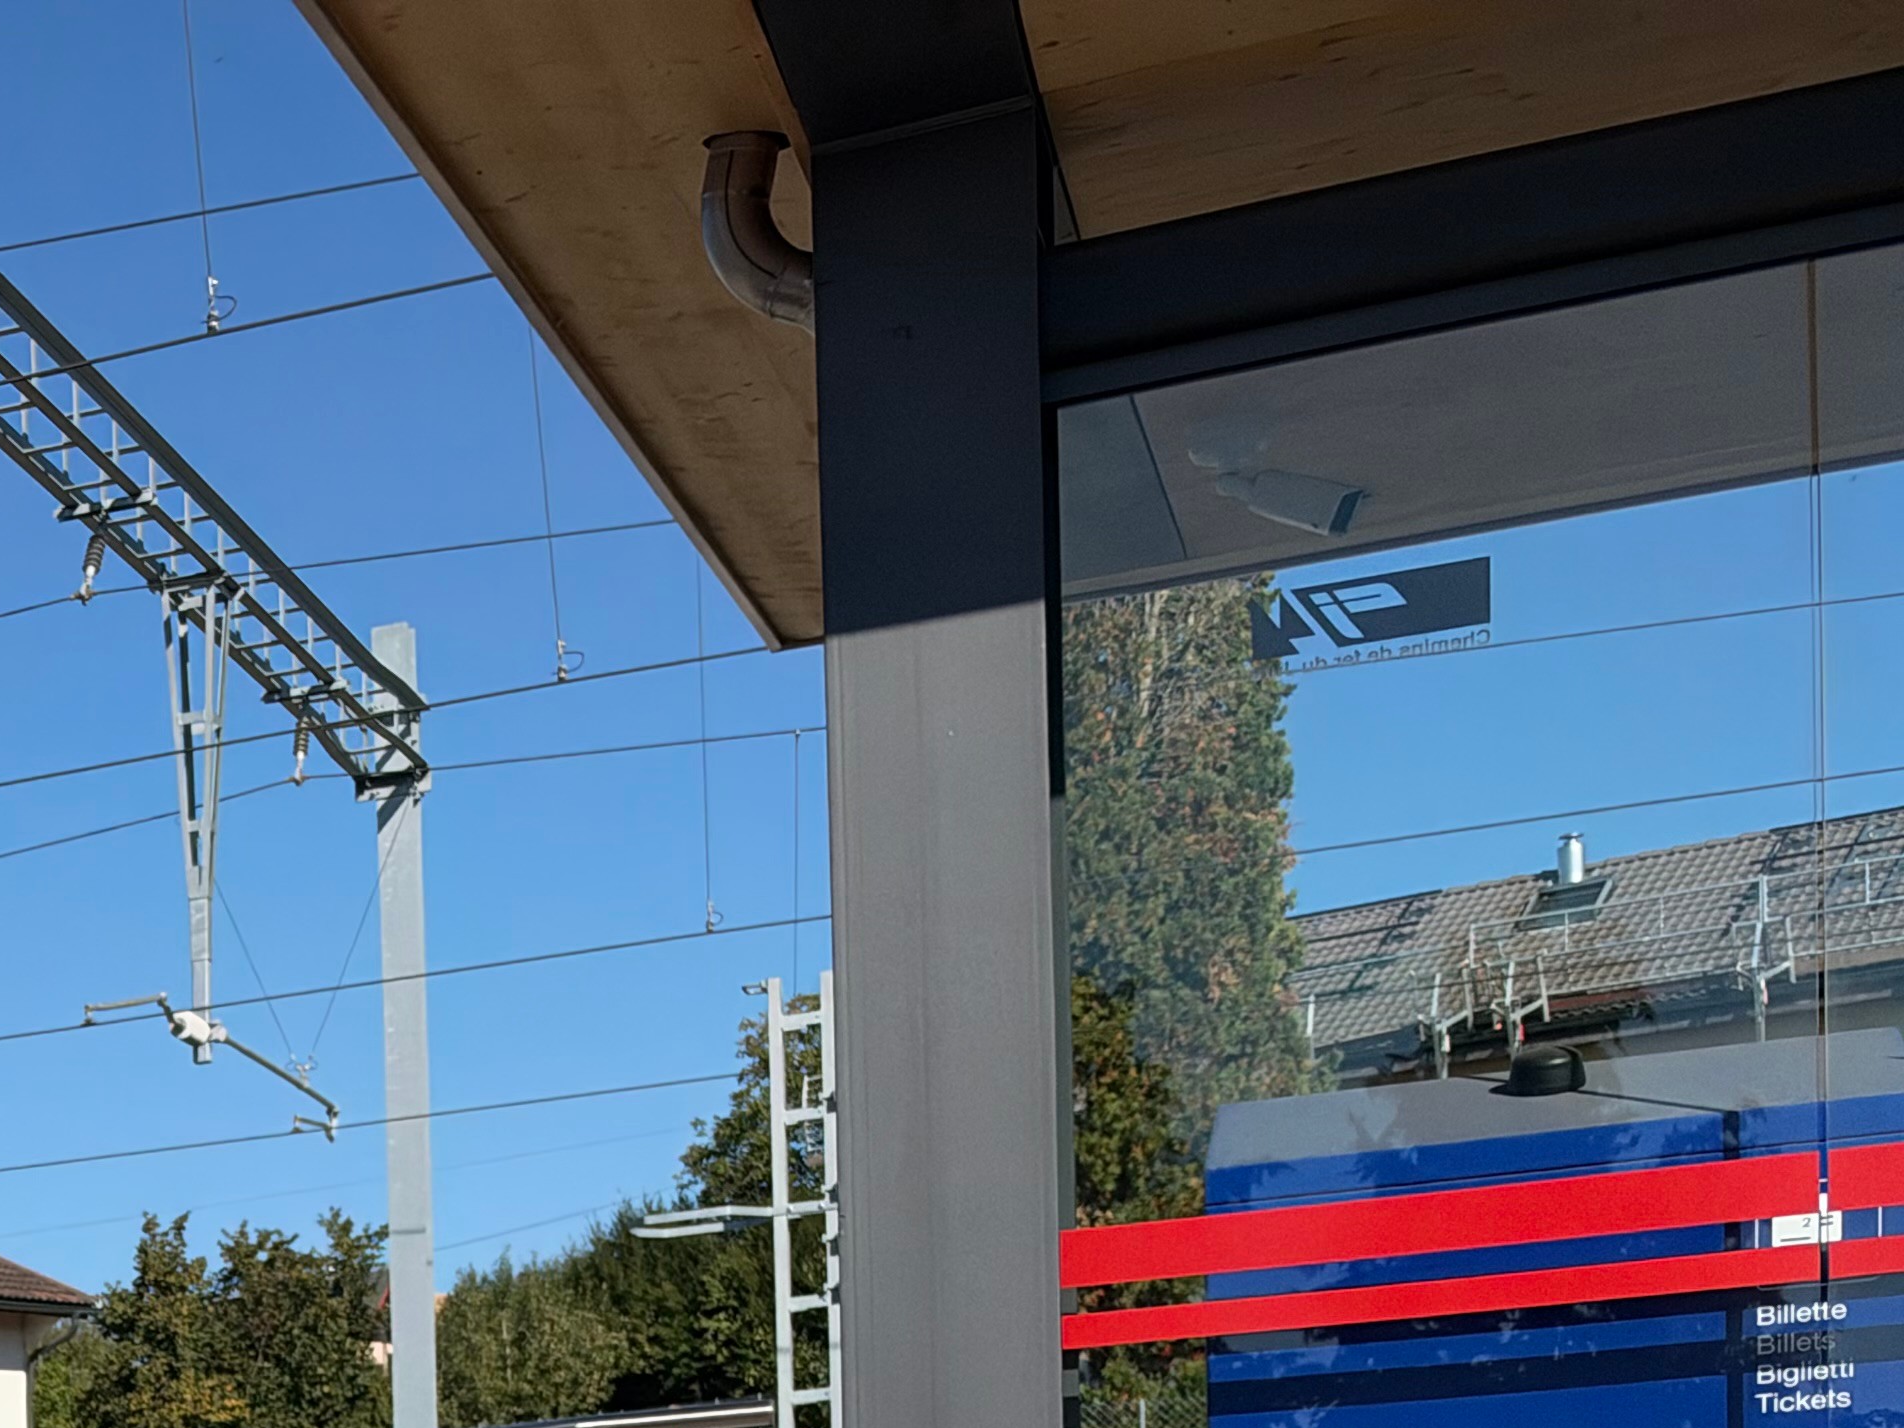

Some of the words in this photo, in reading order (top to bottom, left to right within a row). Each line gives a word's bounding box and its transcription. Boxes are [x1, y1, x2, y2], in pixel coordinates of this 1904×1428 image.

[1756, 1302, 1847, 1326] Billette
[1757, 1332, 1836, 1355] Billets
[1756, 1358, 1854, 1388] Biglietti
[1754, 1389, 1852, 1414] Tickets
